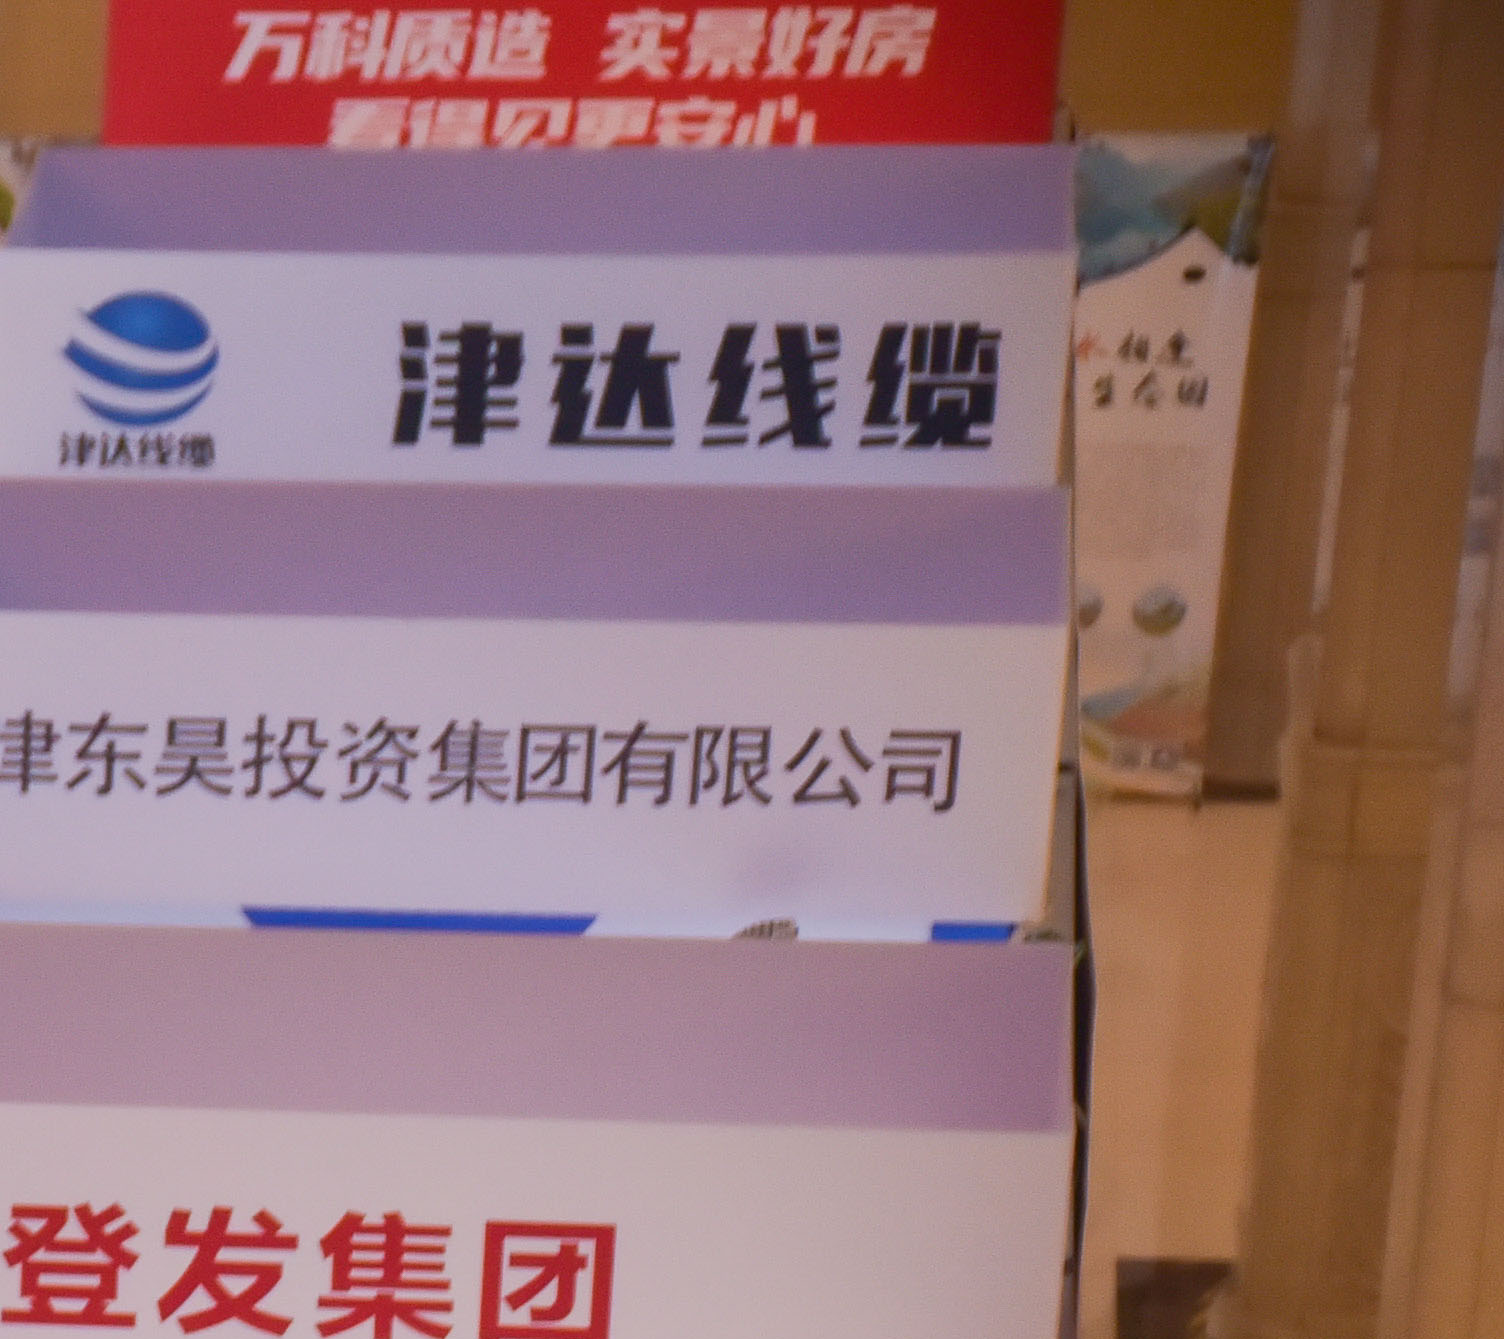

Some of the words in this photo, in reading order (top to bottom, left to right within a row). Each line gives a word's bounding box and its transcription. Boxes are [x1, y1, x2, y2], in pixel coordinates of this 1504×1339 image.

[225, 11, 547, 82] 万科质造
[599, 8, 937, 80] 实景好房
[391, 320, 1001, 448] 津达线缆
